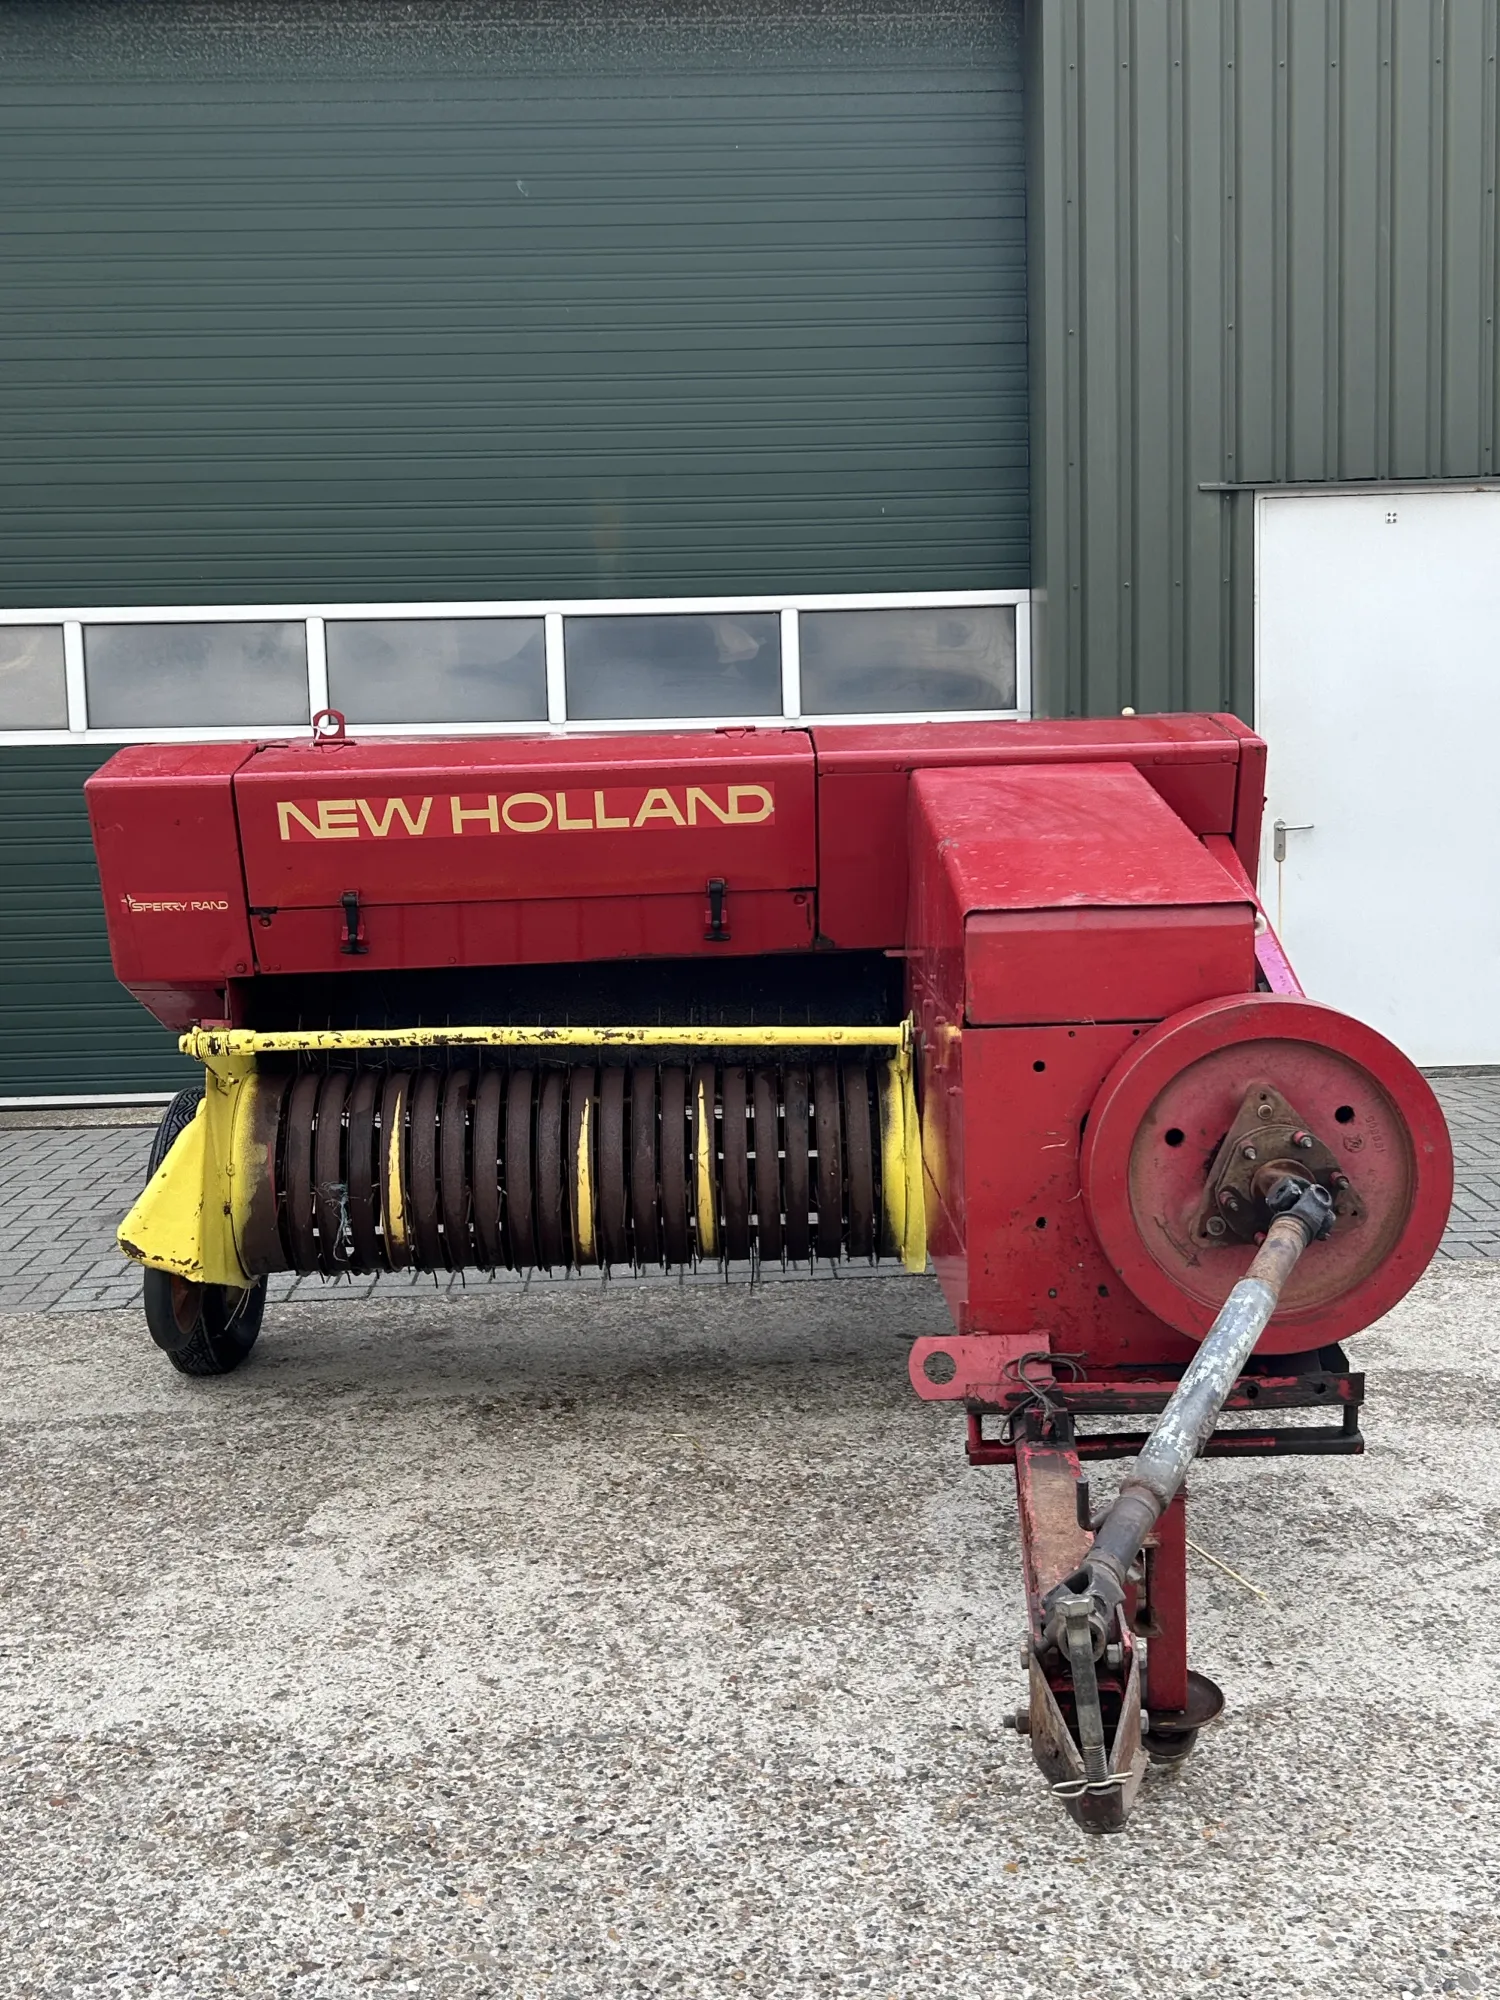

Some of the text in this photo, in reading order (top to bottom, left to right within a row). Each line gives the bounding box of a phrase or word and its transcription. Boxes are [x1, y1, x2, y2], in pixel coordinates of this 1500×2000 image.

[277, 785, 775, 840] NEW HOLLAND
[131, 900, 229, 912] SPERRY RAND
